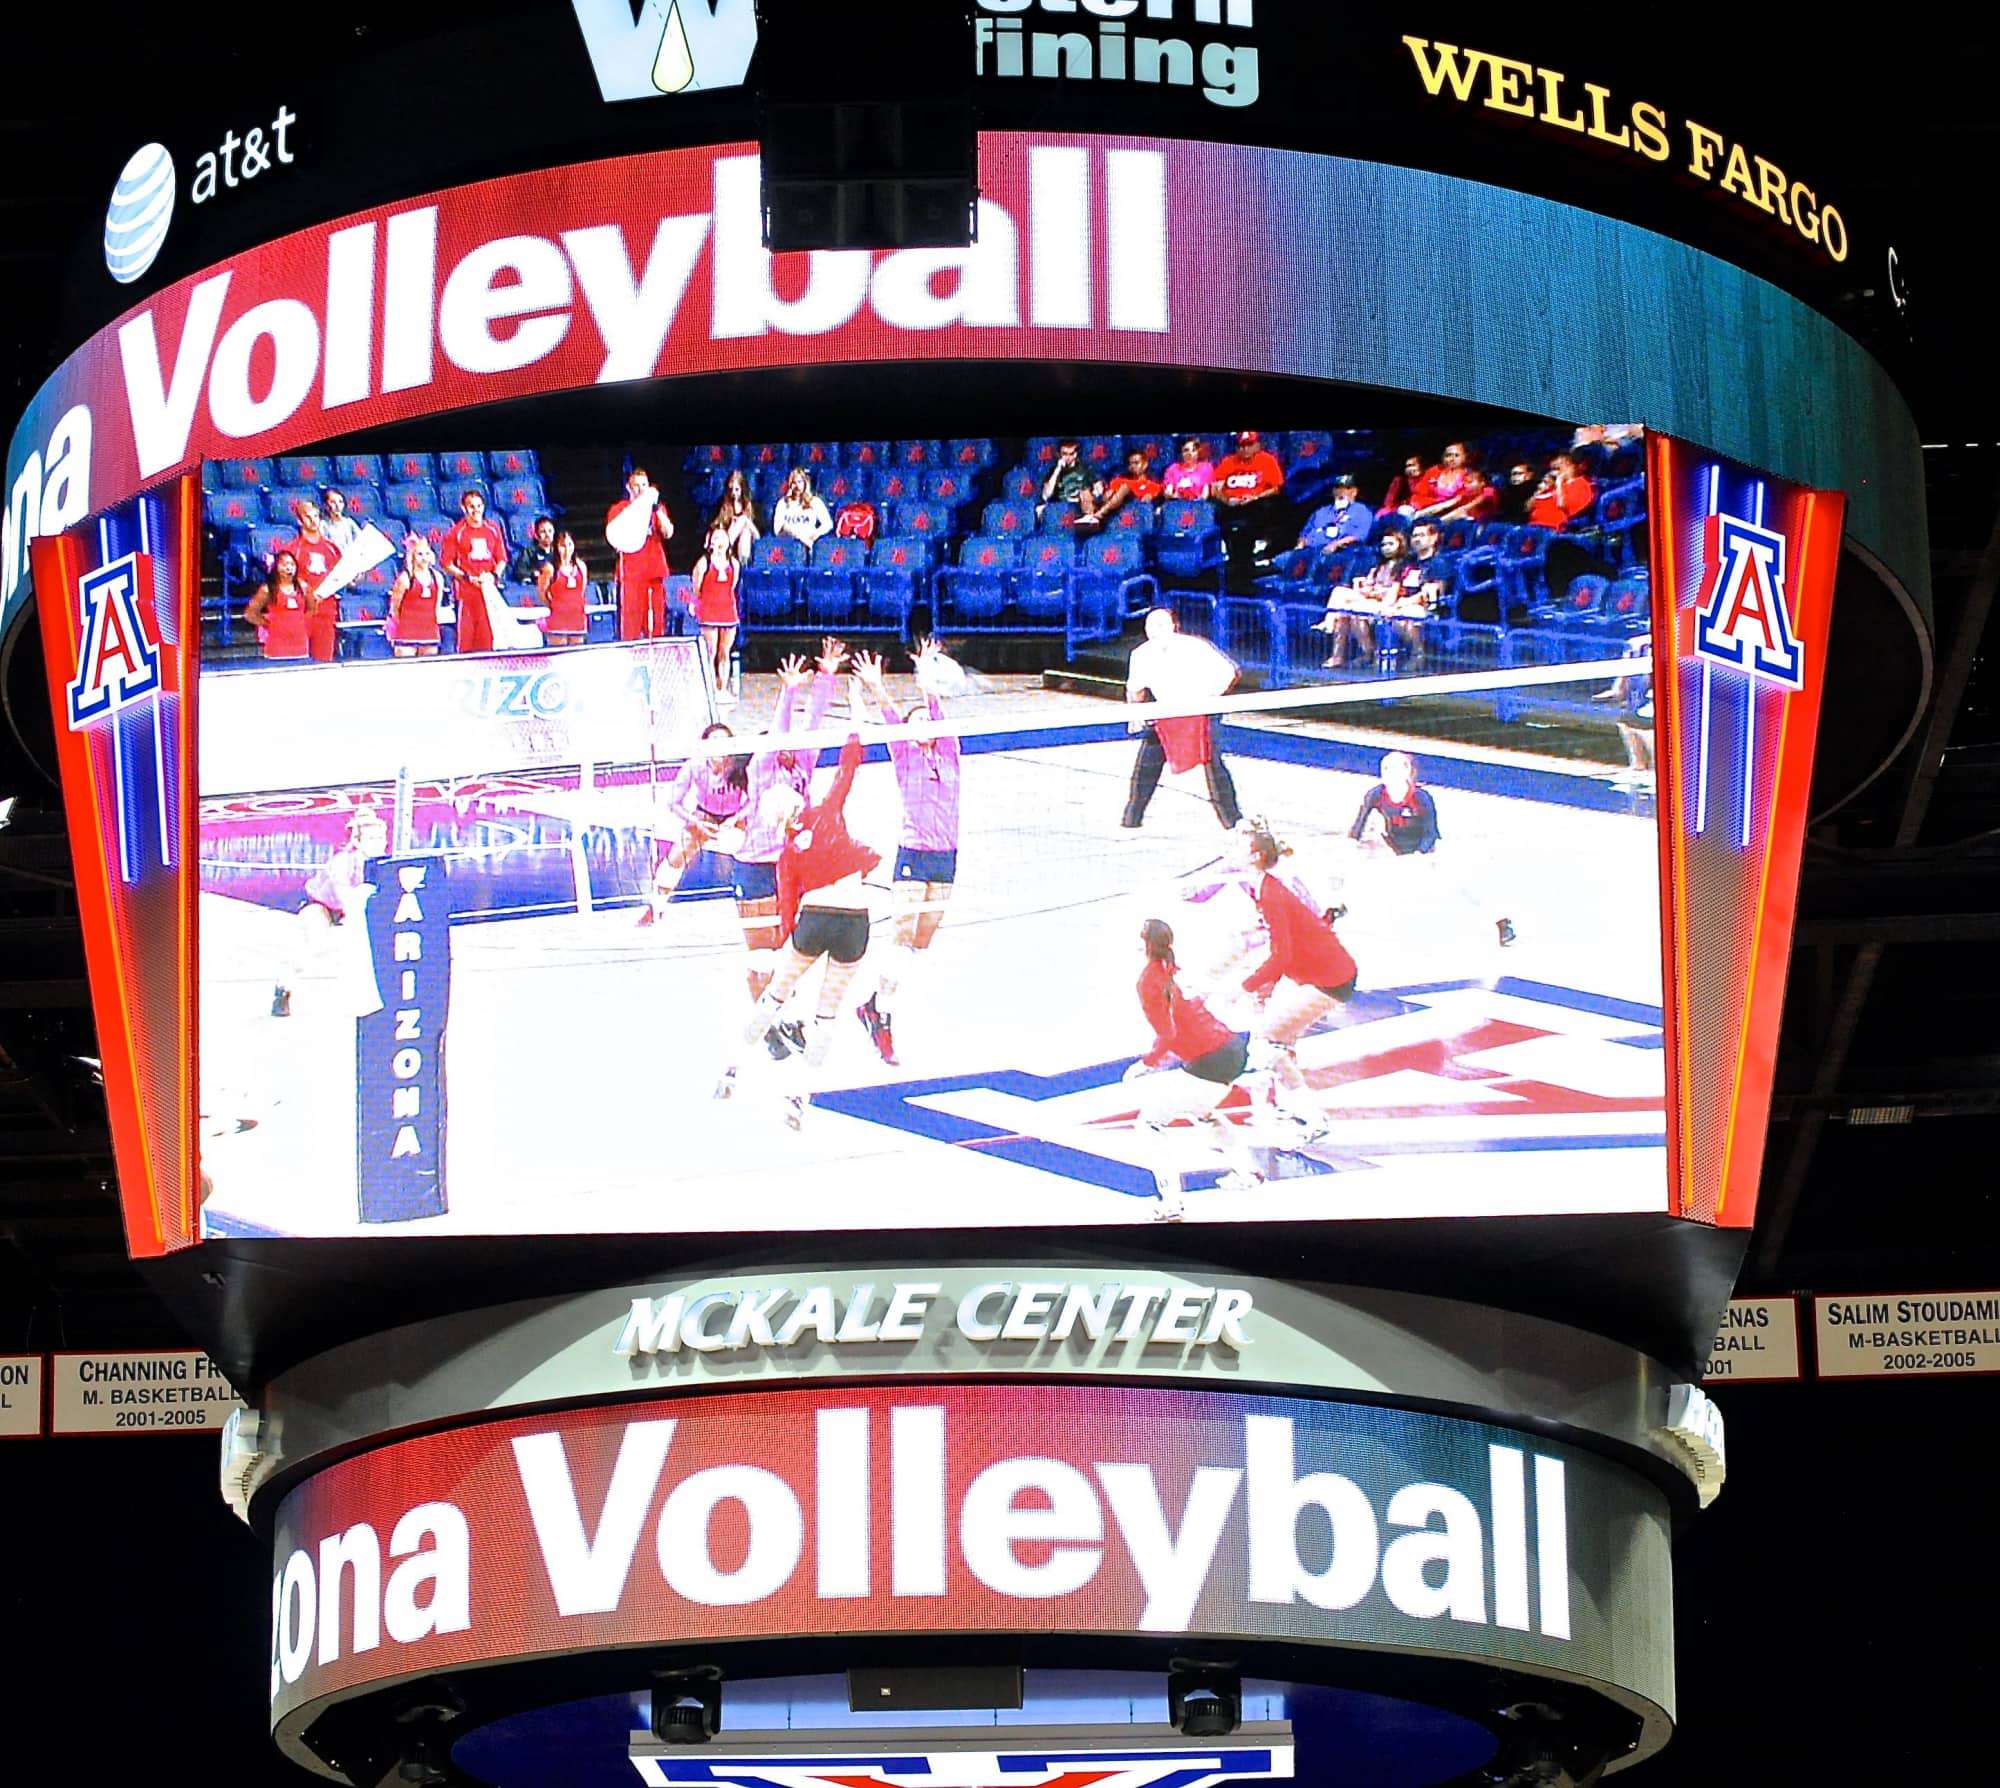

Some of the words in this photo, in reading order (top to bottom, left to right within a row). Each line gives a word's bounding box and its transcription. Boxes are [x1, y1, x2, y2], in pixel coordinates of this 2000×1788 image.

[192, 105, 296, 204] at&t
[1402, 34, 1670, 162] WELLS
[1685, 119, 1848, 262] FARGO
[117, 143, 1170, 480] Volleyball
[391, 890, 425, 1159] ARIZONA
[613, 1281, 942, 1356] MCKALE
[957, 1280, 1255, 1349] CENTER
[1828, 1302, 1889, 1326] SALIM
[1897, 1299, 2000, 1324] STOUDAMI
[1848, 1328, 2000, 1348] M-BASKETBALL
[79, 1359, 187, 1383] CHANNING
[1883, 1352, 1976, 1369] 2002-2005
[0, 1365, 29, 1385] ON
[83, 1390, 104, 1405] M.
[111, 1386, 241, 1405] BASKETBALL
[115, 1409, 206, 1427] 2001-2005
[511, 1402, 1571, 1641] Volleyball
